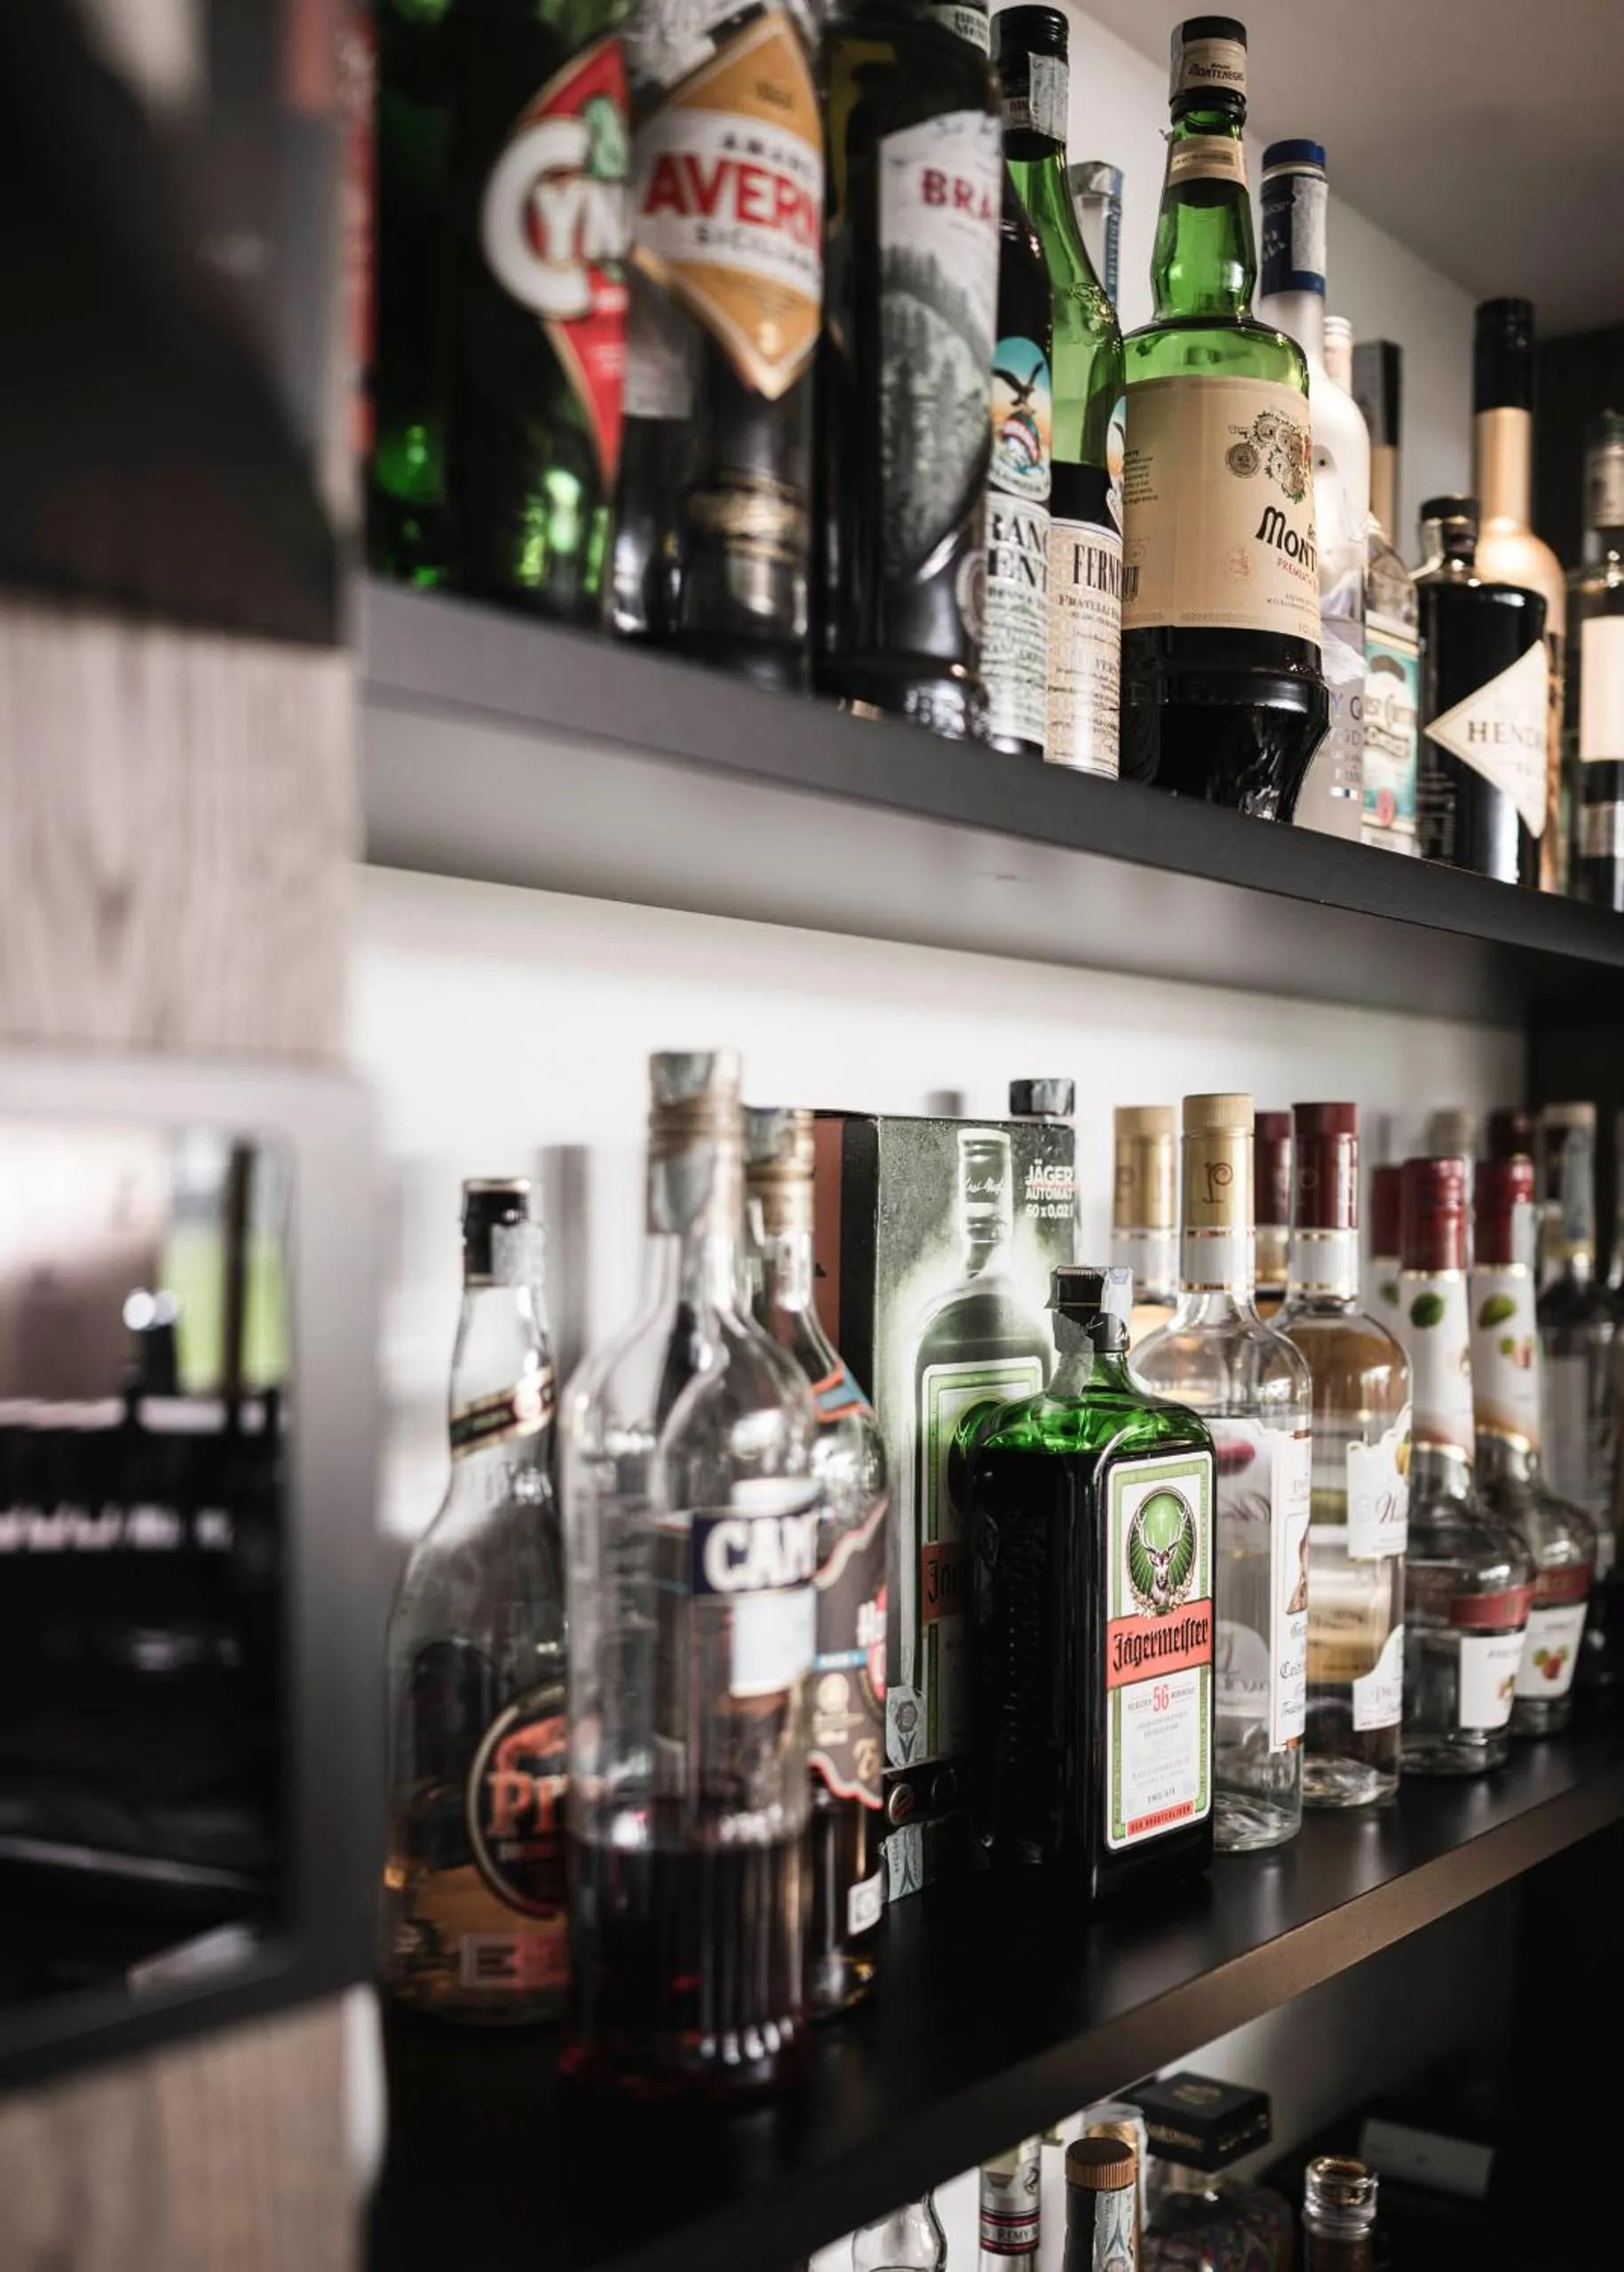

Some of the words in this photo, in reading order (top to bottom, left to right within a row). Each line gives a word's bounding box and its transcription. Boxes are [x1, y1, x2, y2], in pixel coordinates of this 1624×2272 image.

[1025, 1159, 1073, 1186] JÄGER
[1025, 1186, 1073, 1200] AUTOMAT
[1153, 1684, 1169, 1712] 56
